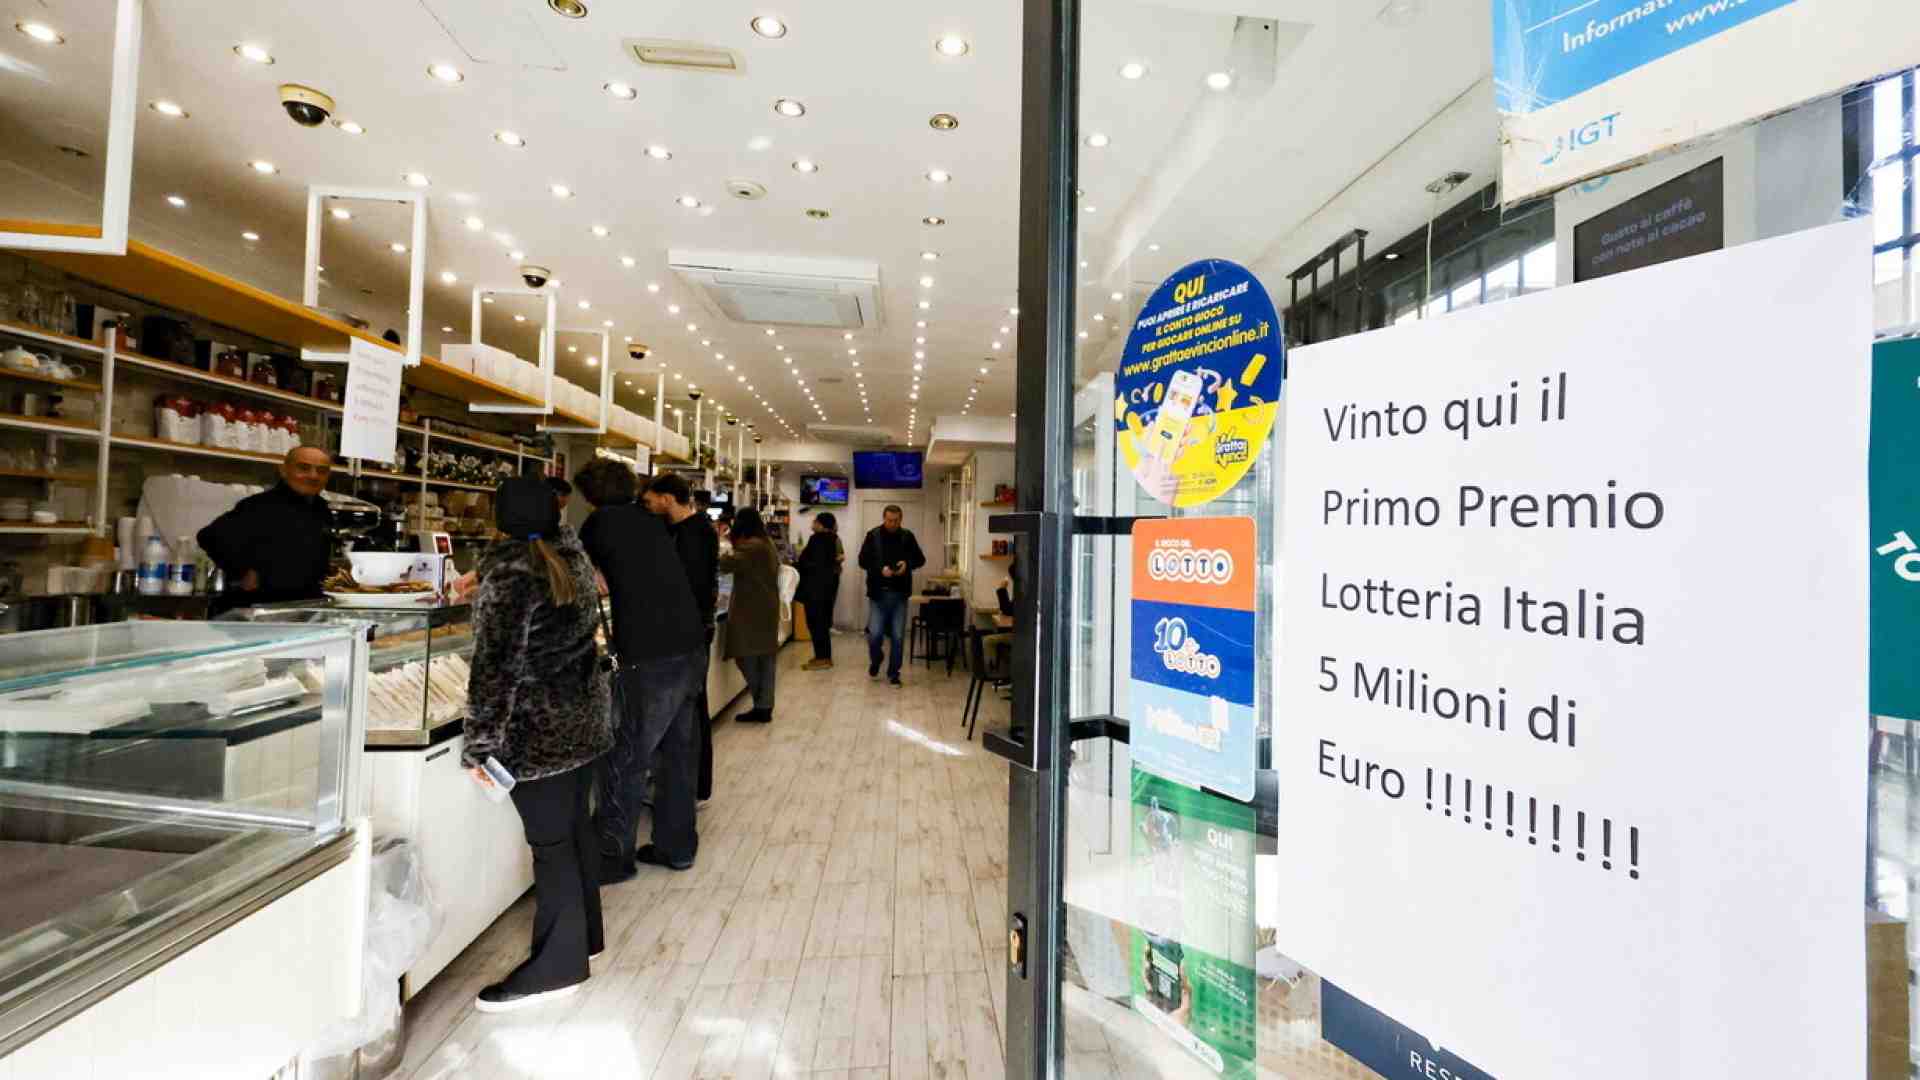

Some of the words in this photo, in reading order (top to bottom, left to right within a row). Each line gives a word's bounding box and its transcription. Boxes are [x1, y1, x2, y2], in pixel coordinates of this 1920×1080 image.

[1562, 0, 1674, 52] Informat
[1157, 304, 1184, 323] APRIRE
[1191, 281, 1249, 311] RICARICARE
[1173, 275, 1205, 304] QUI
[1142, 341, 1157, 354] PER
[1157, 330, 1193, 350] GIOCARE
[1194, 317, 1228, 337] ONLINE
[1228, 312, 1243, 327] SU
[1164, 316, 1193, 333] CONTO
[1194, 305, 1224, 323] GIOCO
[1124, 320, 1269, 377] www.grattaevincionline.it
[1324, 402, 1426, 441] Vinto
[1445, 381, 1517, 440] qui
[1542, 373, 1566, 421] il
[1325, 488, 1439, 526] Primo
[1460, 480, 1663, 529] Premio
[1150, 550, 1231, 582] LOTTO
[1323, 574, 1480, 625] Lotteria
[1504, 587, 1643, 645] Italia
[1154, 617, 1187, 652] 10
[1320, 656, 1337, 691] 5
[1355, 663, 1505, 731] Milioni
[1528, 695, 1575, 747] di
[1320, 740, 1404, 798] Euro
[1426, 768, 1638, 879] !!!!!!!!!!
[1410, 1050, 1463, 1080] RES
